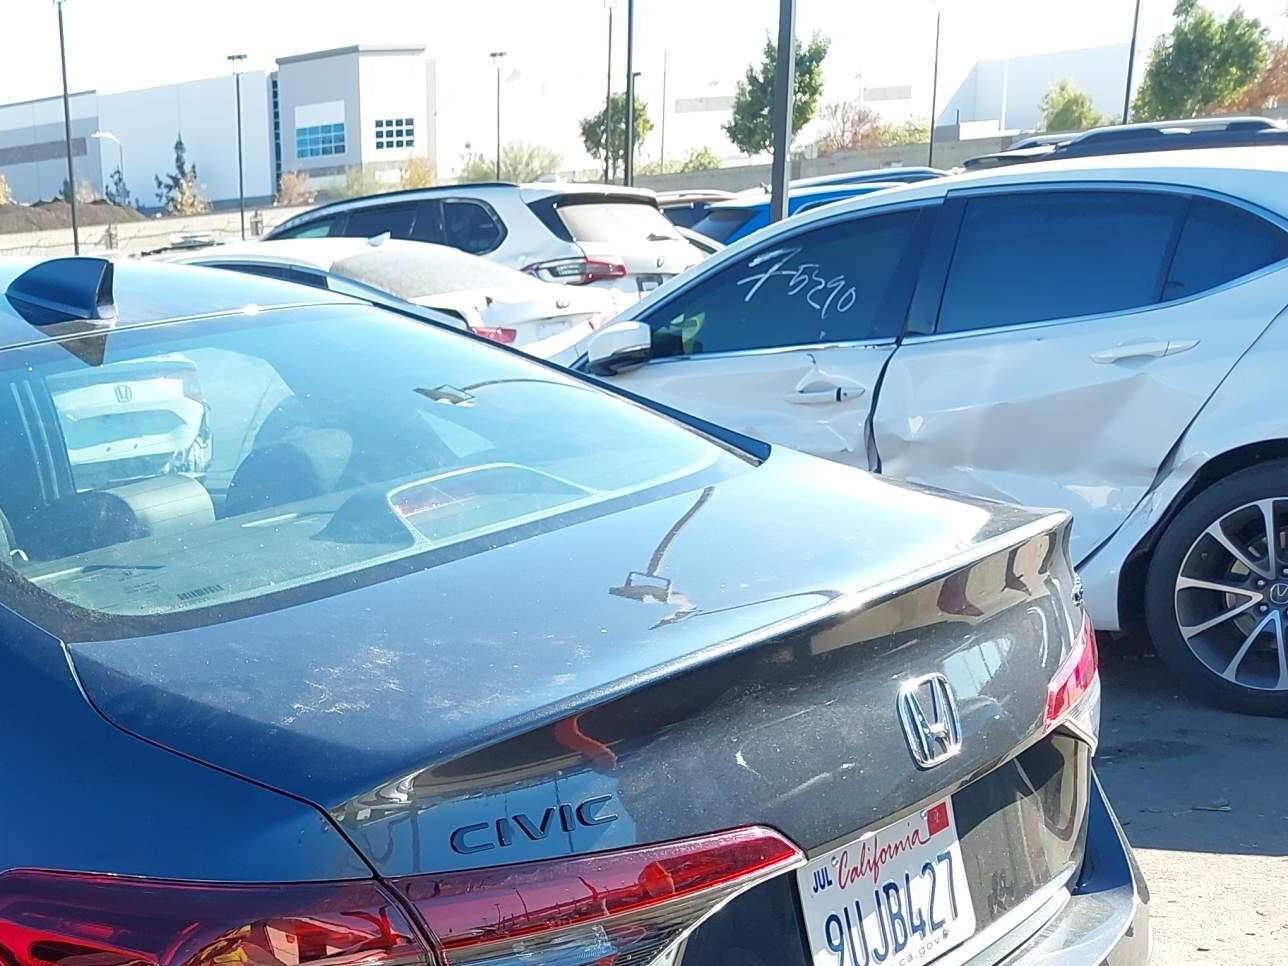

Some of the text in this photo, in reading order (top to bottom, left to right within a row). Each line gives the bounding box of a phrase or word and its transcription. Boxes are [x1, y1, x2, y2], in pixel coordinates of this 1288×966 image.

[450, 794, 619, 855] CIVIC
[812, 866, 833, 894] JUL
[837, 822, 931, 891] California
